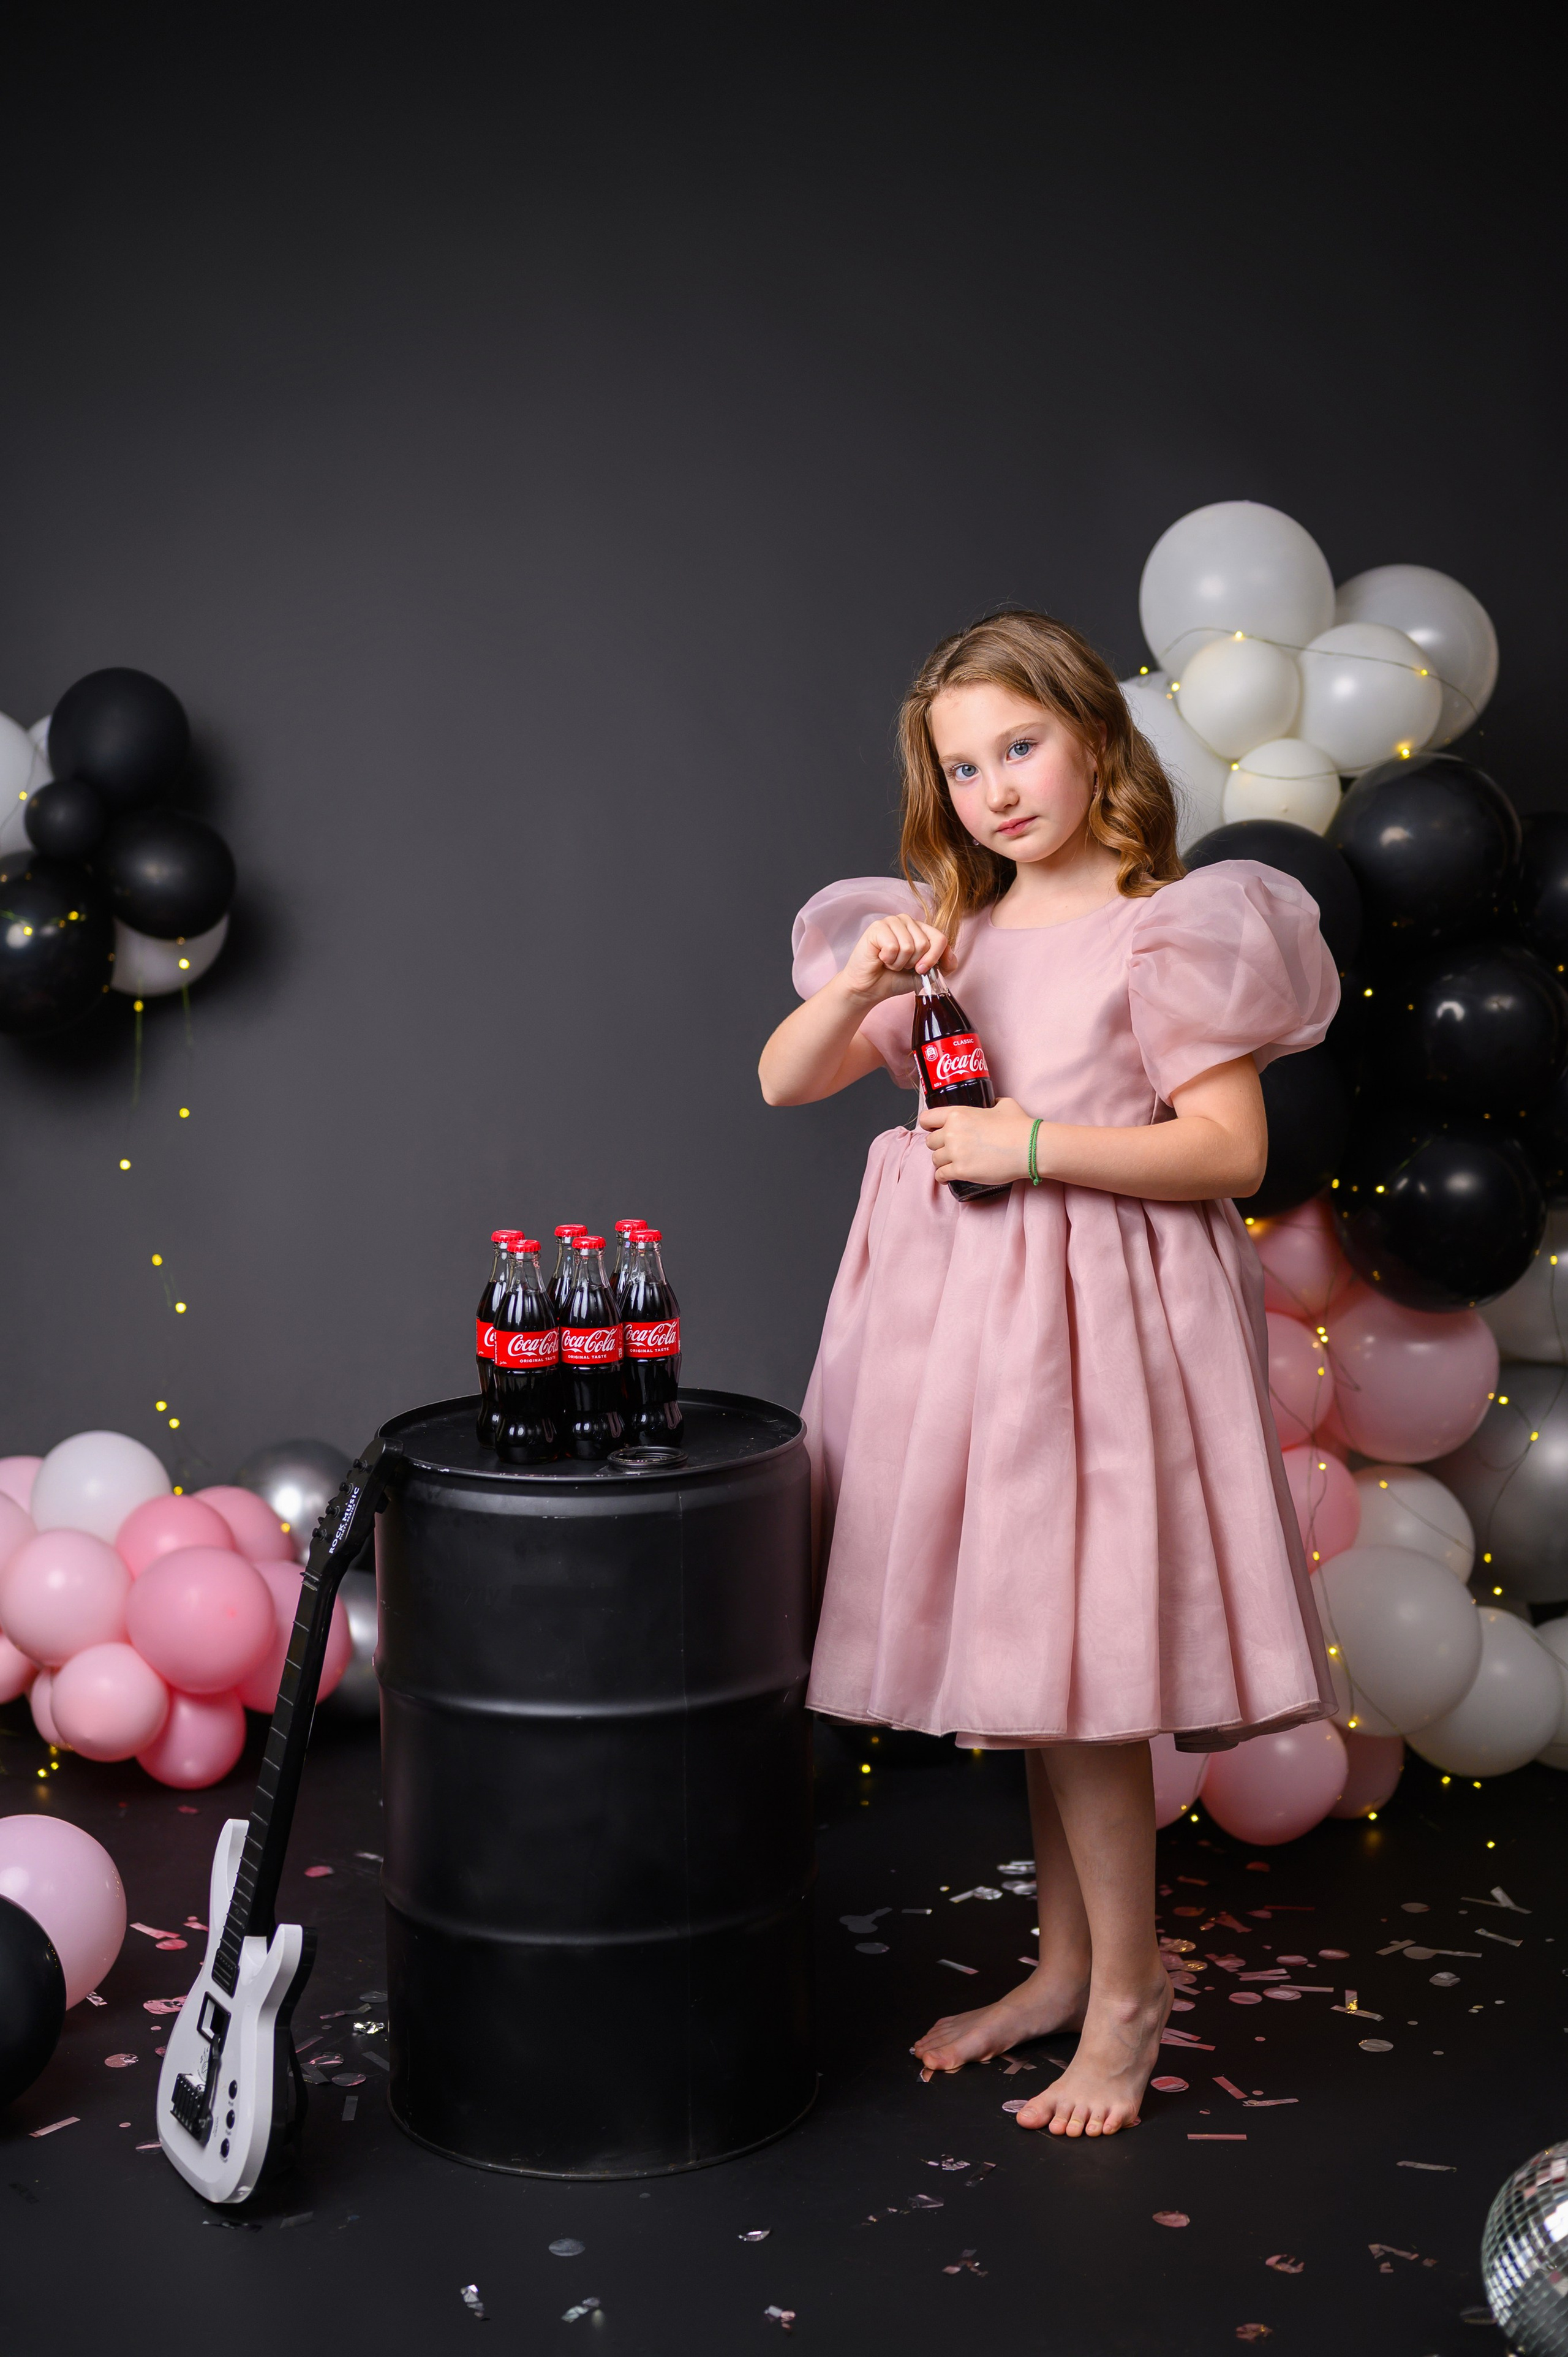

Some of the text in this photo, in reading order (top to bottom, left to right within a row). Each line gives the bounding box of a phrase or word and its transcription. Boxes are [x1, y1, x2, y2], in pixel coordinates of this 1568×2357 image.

[561, 1328, 617, 1353] Coca-Cola
[623, 1321, 677, 1346] Coca-Cola
[328, 1487, 360, 1554] ROCK MUSIC
